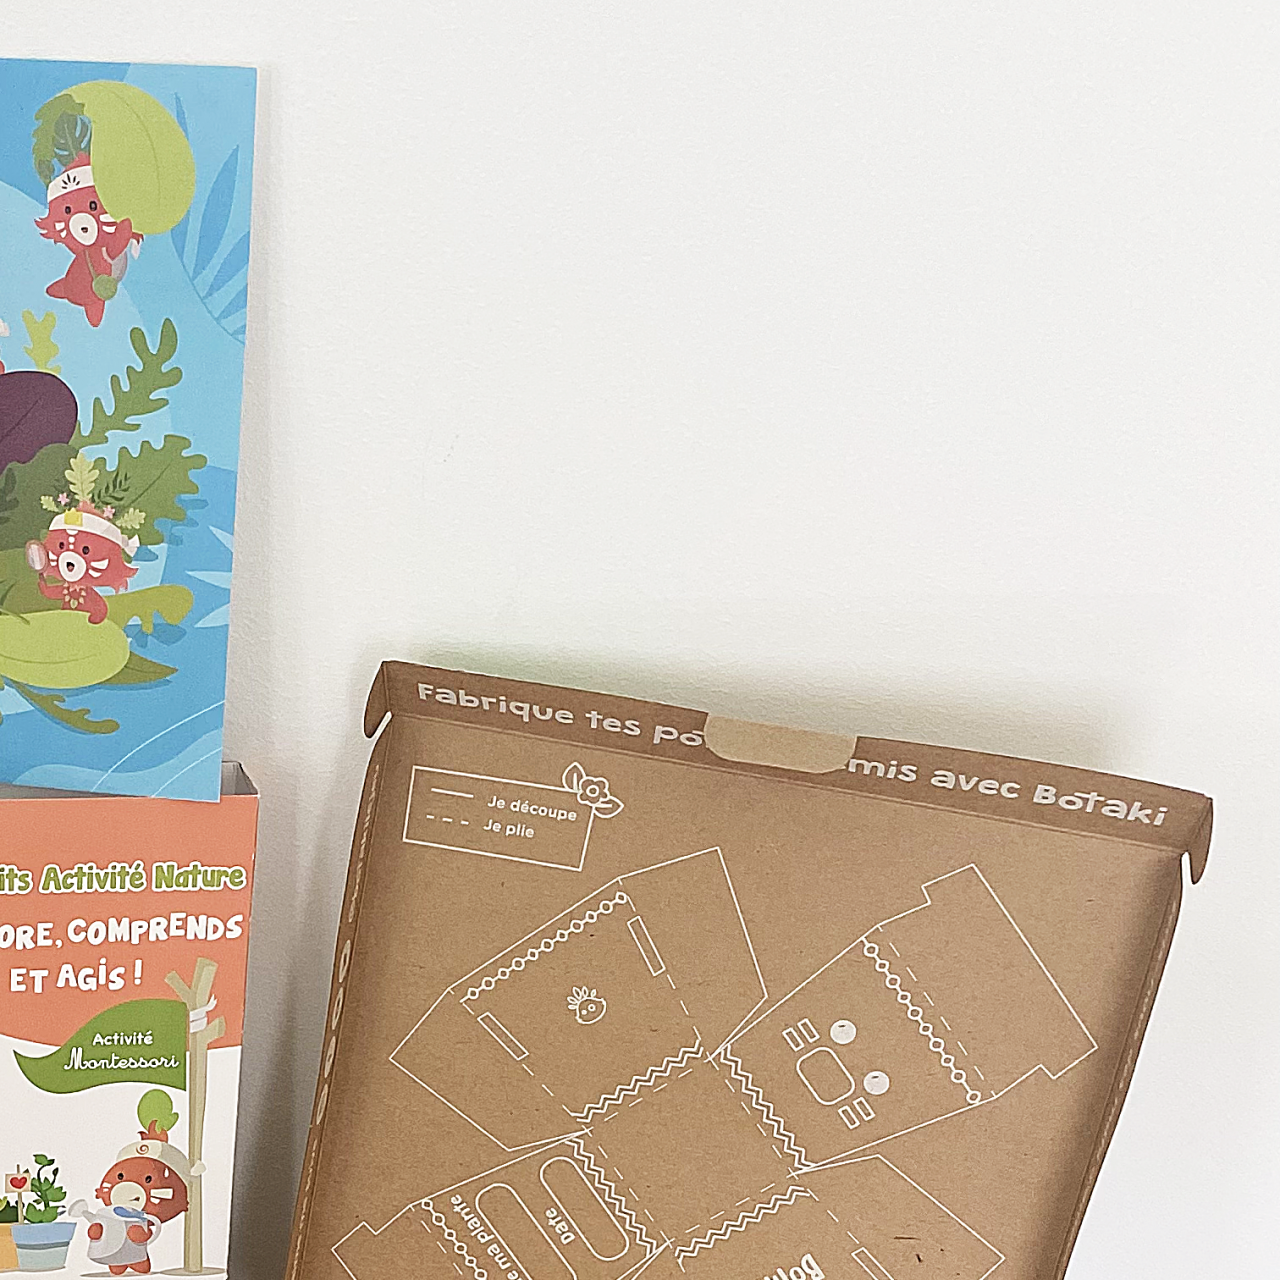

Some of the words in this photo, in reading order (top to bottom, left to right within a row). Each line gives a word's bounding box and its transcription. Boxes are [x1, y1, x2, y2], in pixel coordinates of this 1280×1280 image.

[417, 682, 574, 724] Fabrique
[585, 710, 641, 736] tes
[930, 767, 1021, 800] avec
[1033, 783, 1169, 828] Botaki
[487, 795, 506, 809] Je
[510, 798, 578, 822] découpe
[482, 818, 501, 833] Je
[504, 821, 535, 839] plie
[41, 862, 144, 894] Activité
[153, 863, 246, 891] Nature
[67, 912, 244, 946] COMPRENDS
[9, 967, 49, 993] ET
[133, 959, 143, 986] !
[92, 1031, 153, 1047] Activité
[63, 1046, 180, 1072] Montessori
[450, 1193, 497, 1246] plante
[544, 1207, 576, 1245] Date
[486, 1243, 511, 1271] ma
